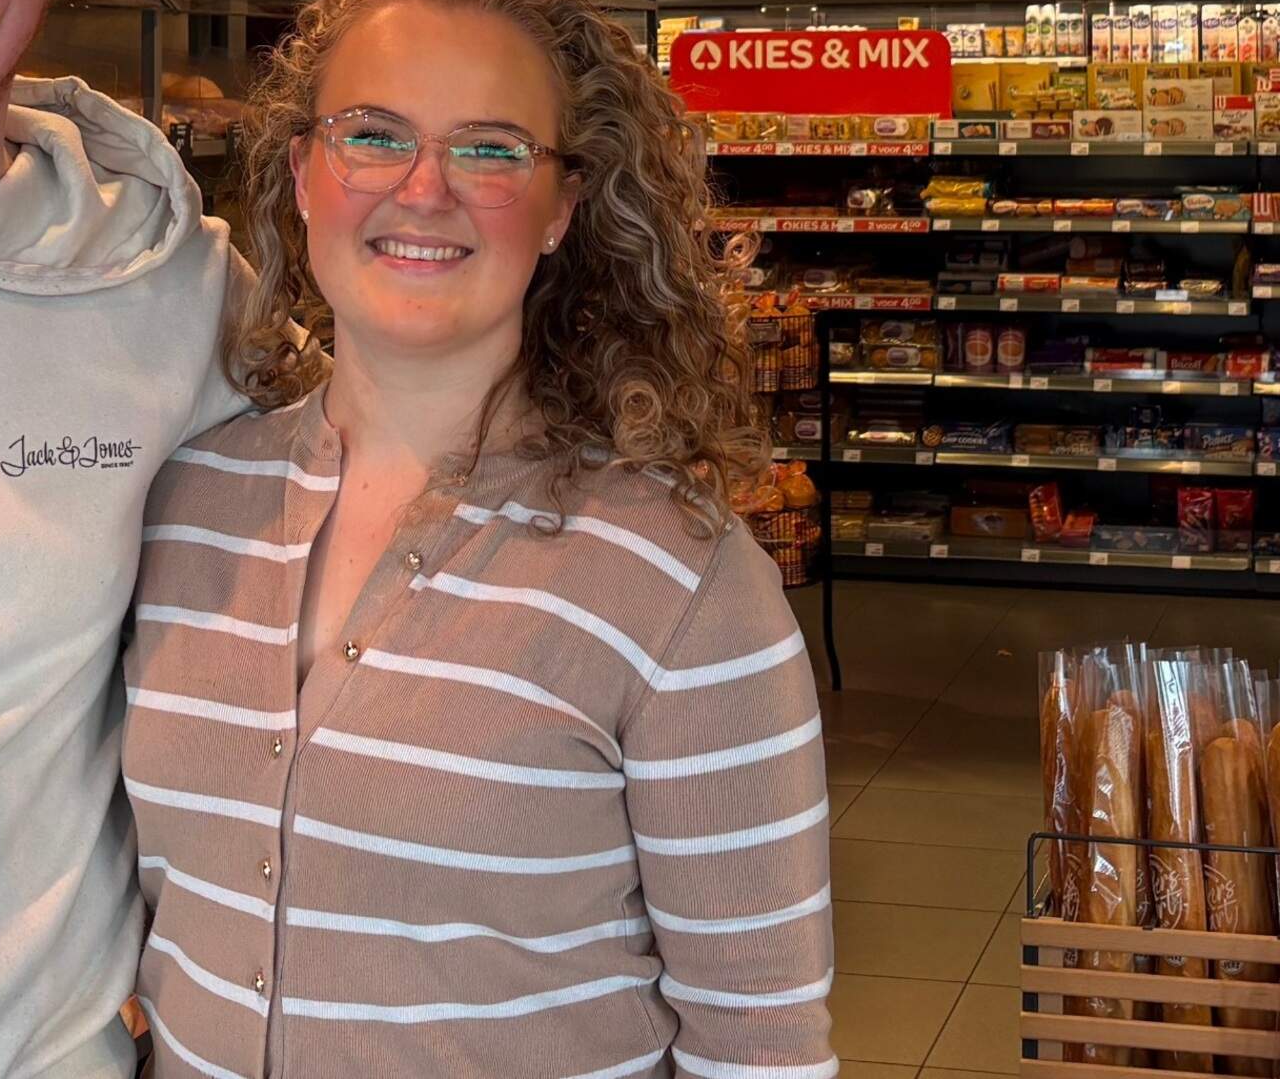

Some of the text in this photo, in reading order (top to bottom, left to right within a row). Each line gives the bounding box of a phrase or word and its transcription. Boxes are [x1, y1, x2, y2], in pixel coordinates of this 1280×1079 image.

[728, 37, 930, 70] KIES & MIX
[795, 144, 818, 155] KIES
[0, 434, 143, 478] Jack & Jones
